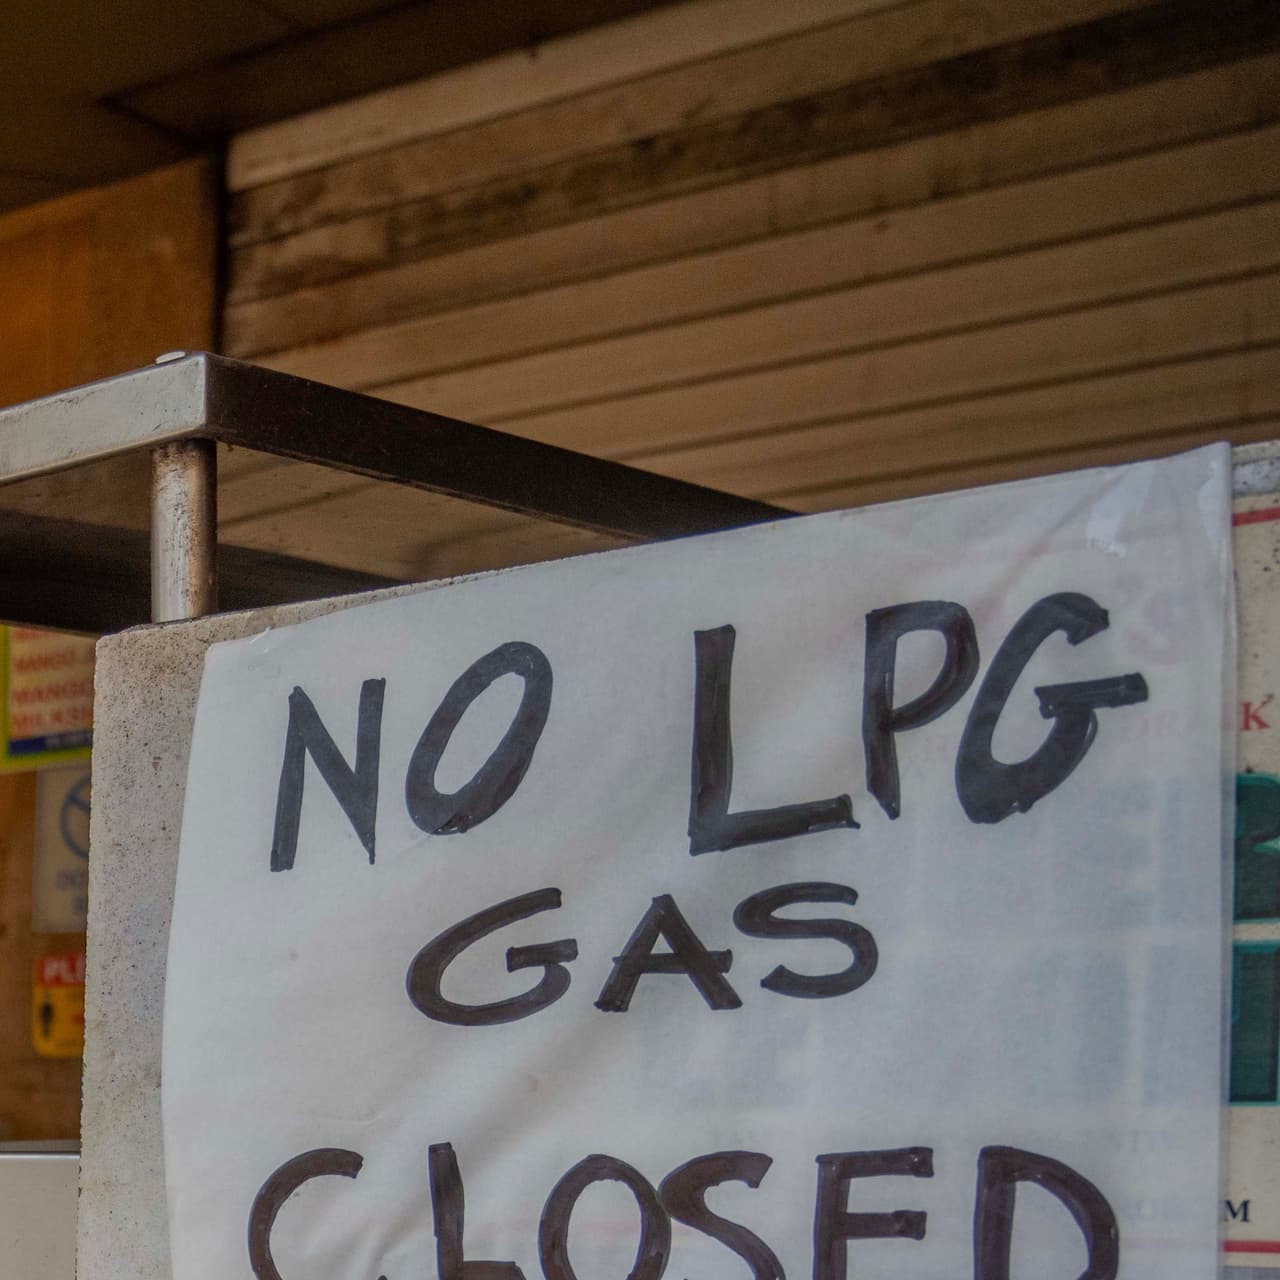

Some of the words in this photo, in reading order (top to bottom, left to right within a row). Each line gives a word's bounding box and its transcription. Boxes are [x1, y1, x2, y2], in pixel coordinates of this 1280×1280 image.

[270, 640, 554, 873] NO
[687, 592, 1150, 856] LPG
[405, 881, 879, 1027] GAS
